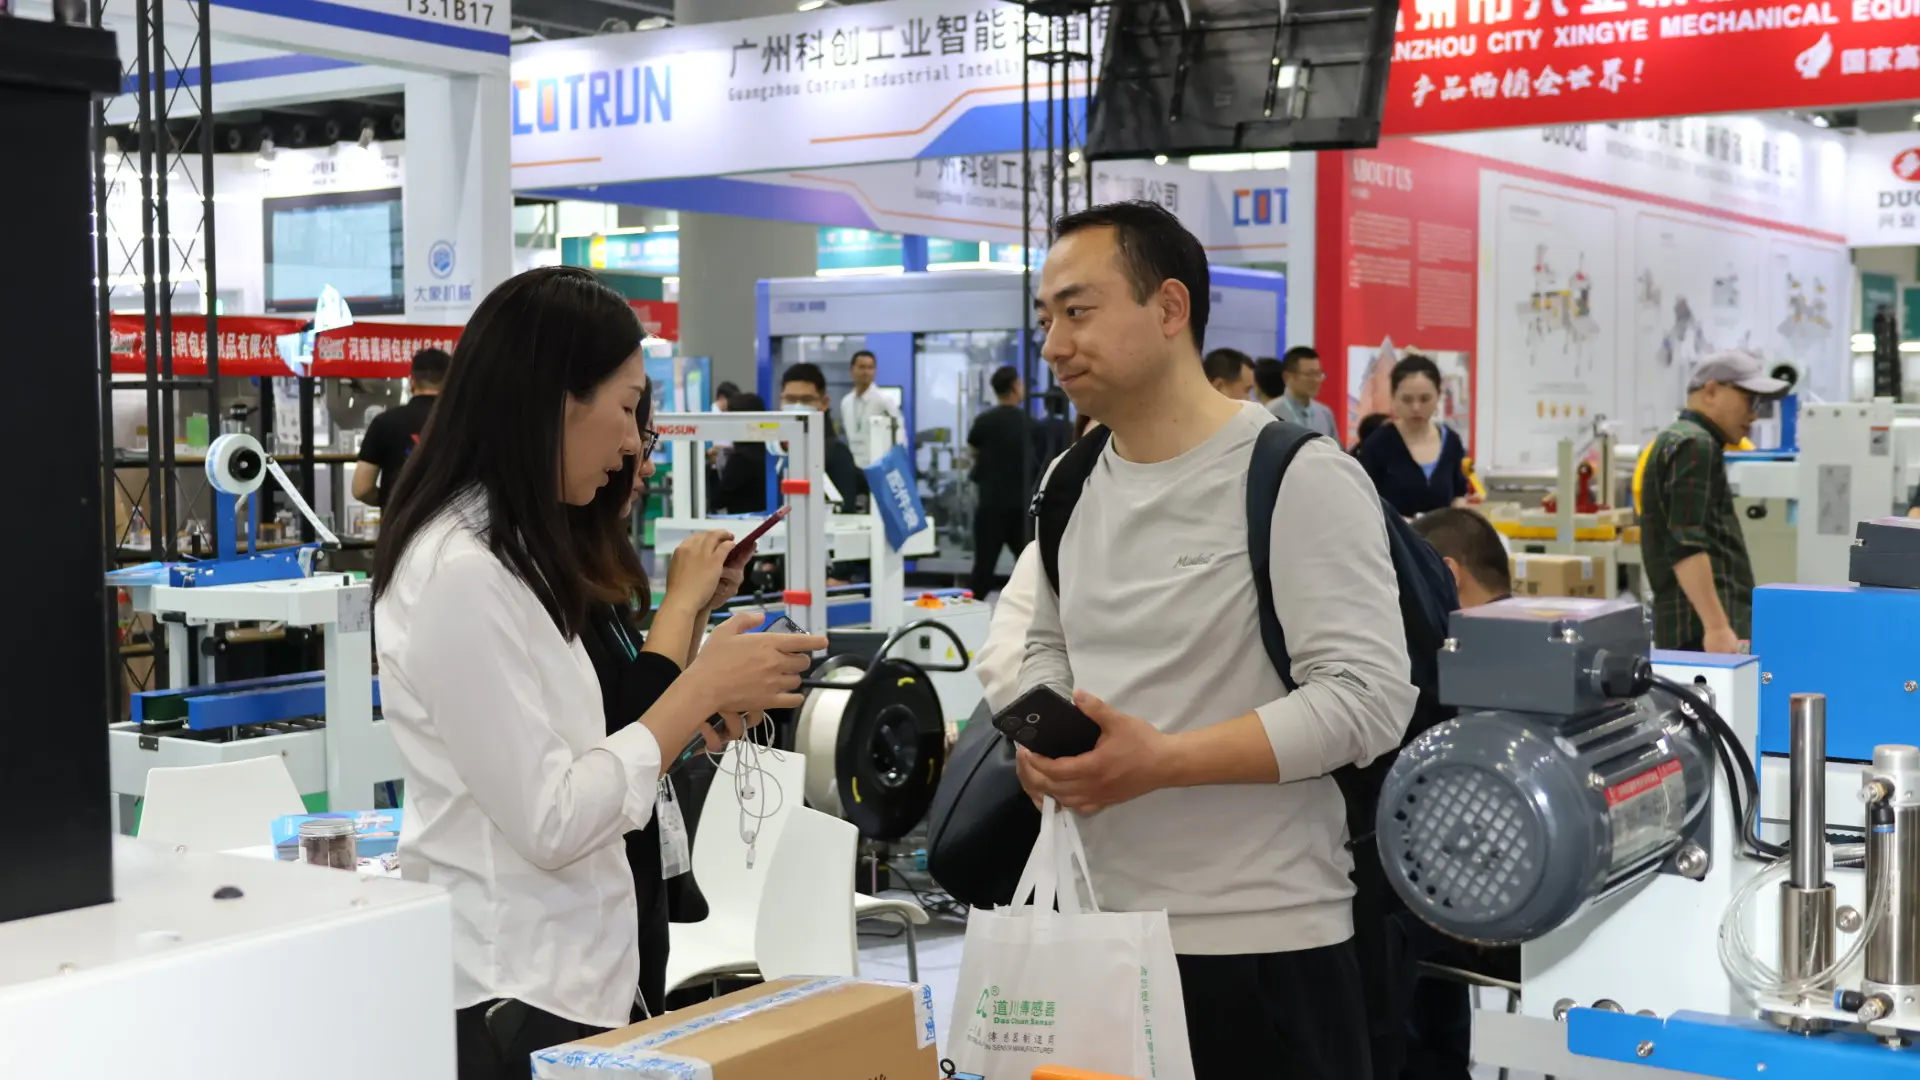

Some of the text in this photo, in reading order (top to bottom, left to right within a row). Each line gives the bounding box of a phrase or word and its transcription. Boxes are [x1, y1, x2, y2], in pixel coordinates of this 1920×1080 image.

[1391, 34, 1477, 62] NZHOU
[1487, 28, 1543, 54] CITY
[1554, 19, 1649, 48] XINGYE
[1660, 1, 1840, 38] MECHANICAL
[512, 65, 672, 136] COTRUN
[728, 83, 801, 102] Guangzhou
[806, 77, 856, 95] Cotrun
[864, 64, 950, 89] Industrial
[1395, 165, 1414, 193] US
